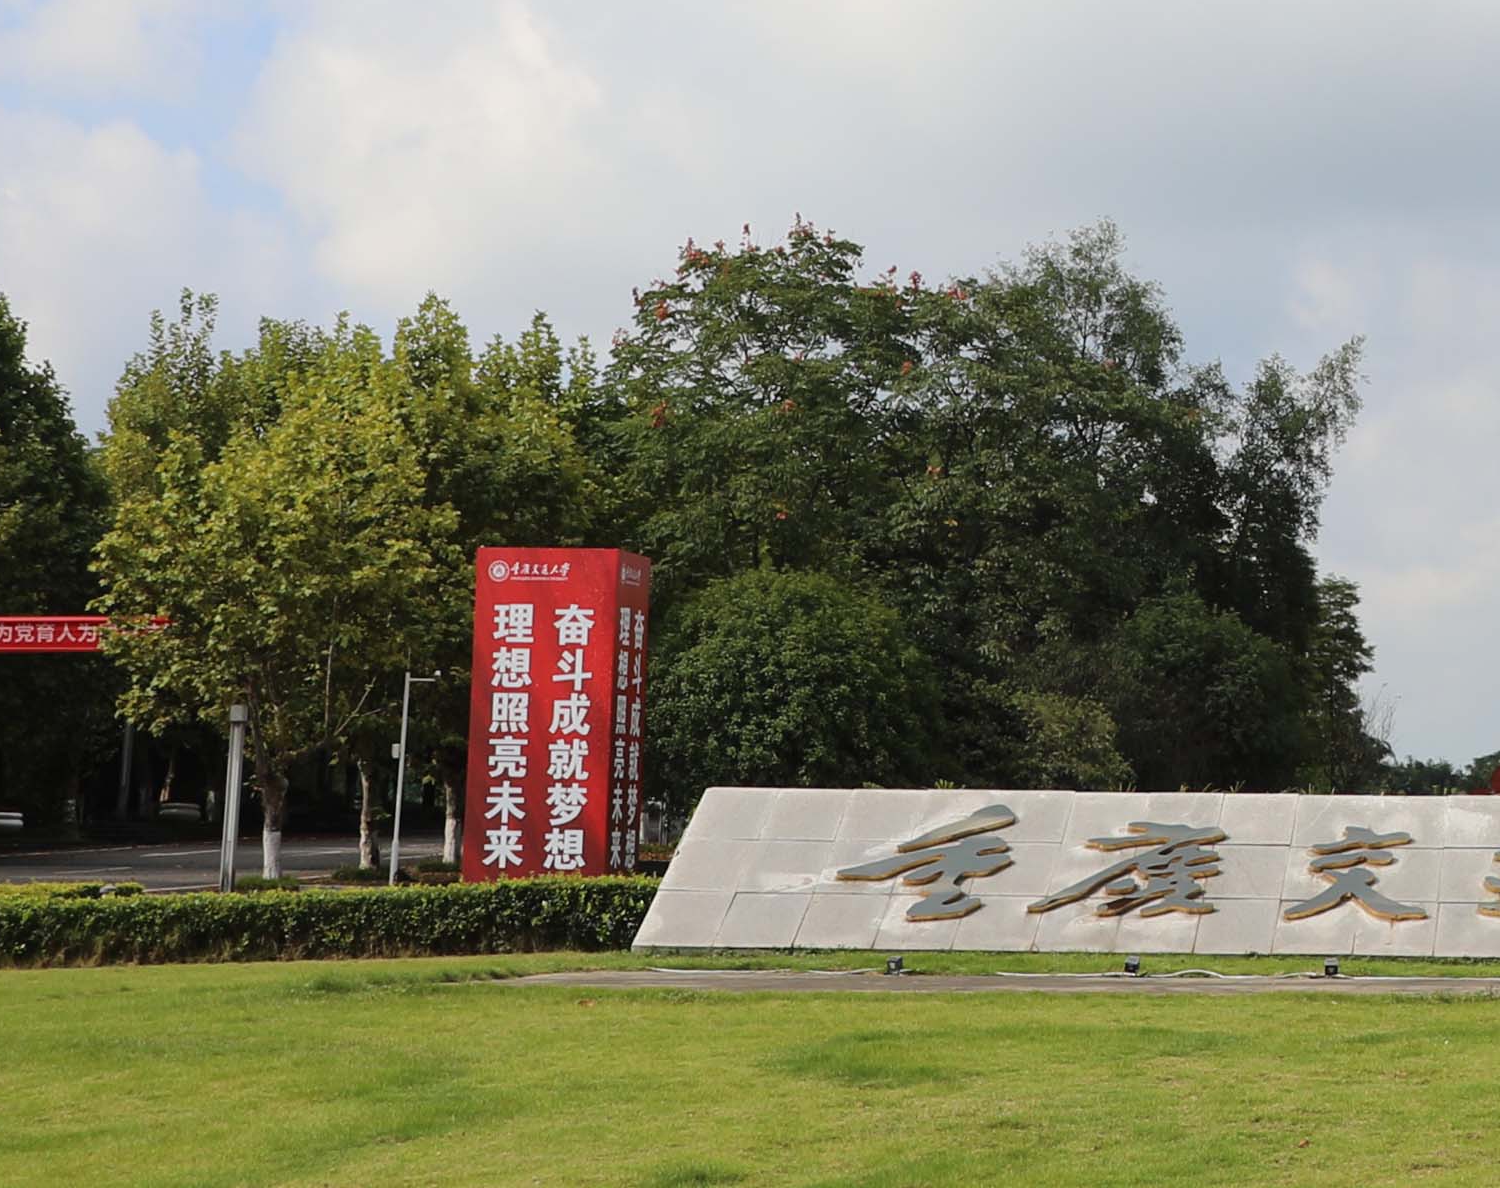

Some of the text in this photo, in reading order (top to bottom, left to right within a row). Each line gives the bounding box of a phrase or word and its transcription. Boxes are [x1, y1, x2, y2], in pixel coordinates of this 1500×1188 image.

[482, 603, 536, 869] 理想照亮未来
[542, 603, 596, 871] 奋斗成就梦想
